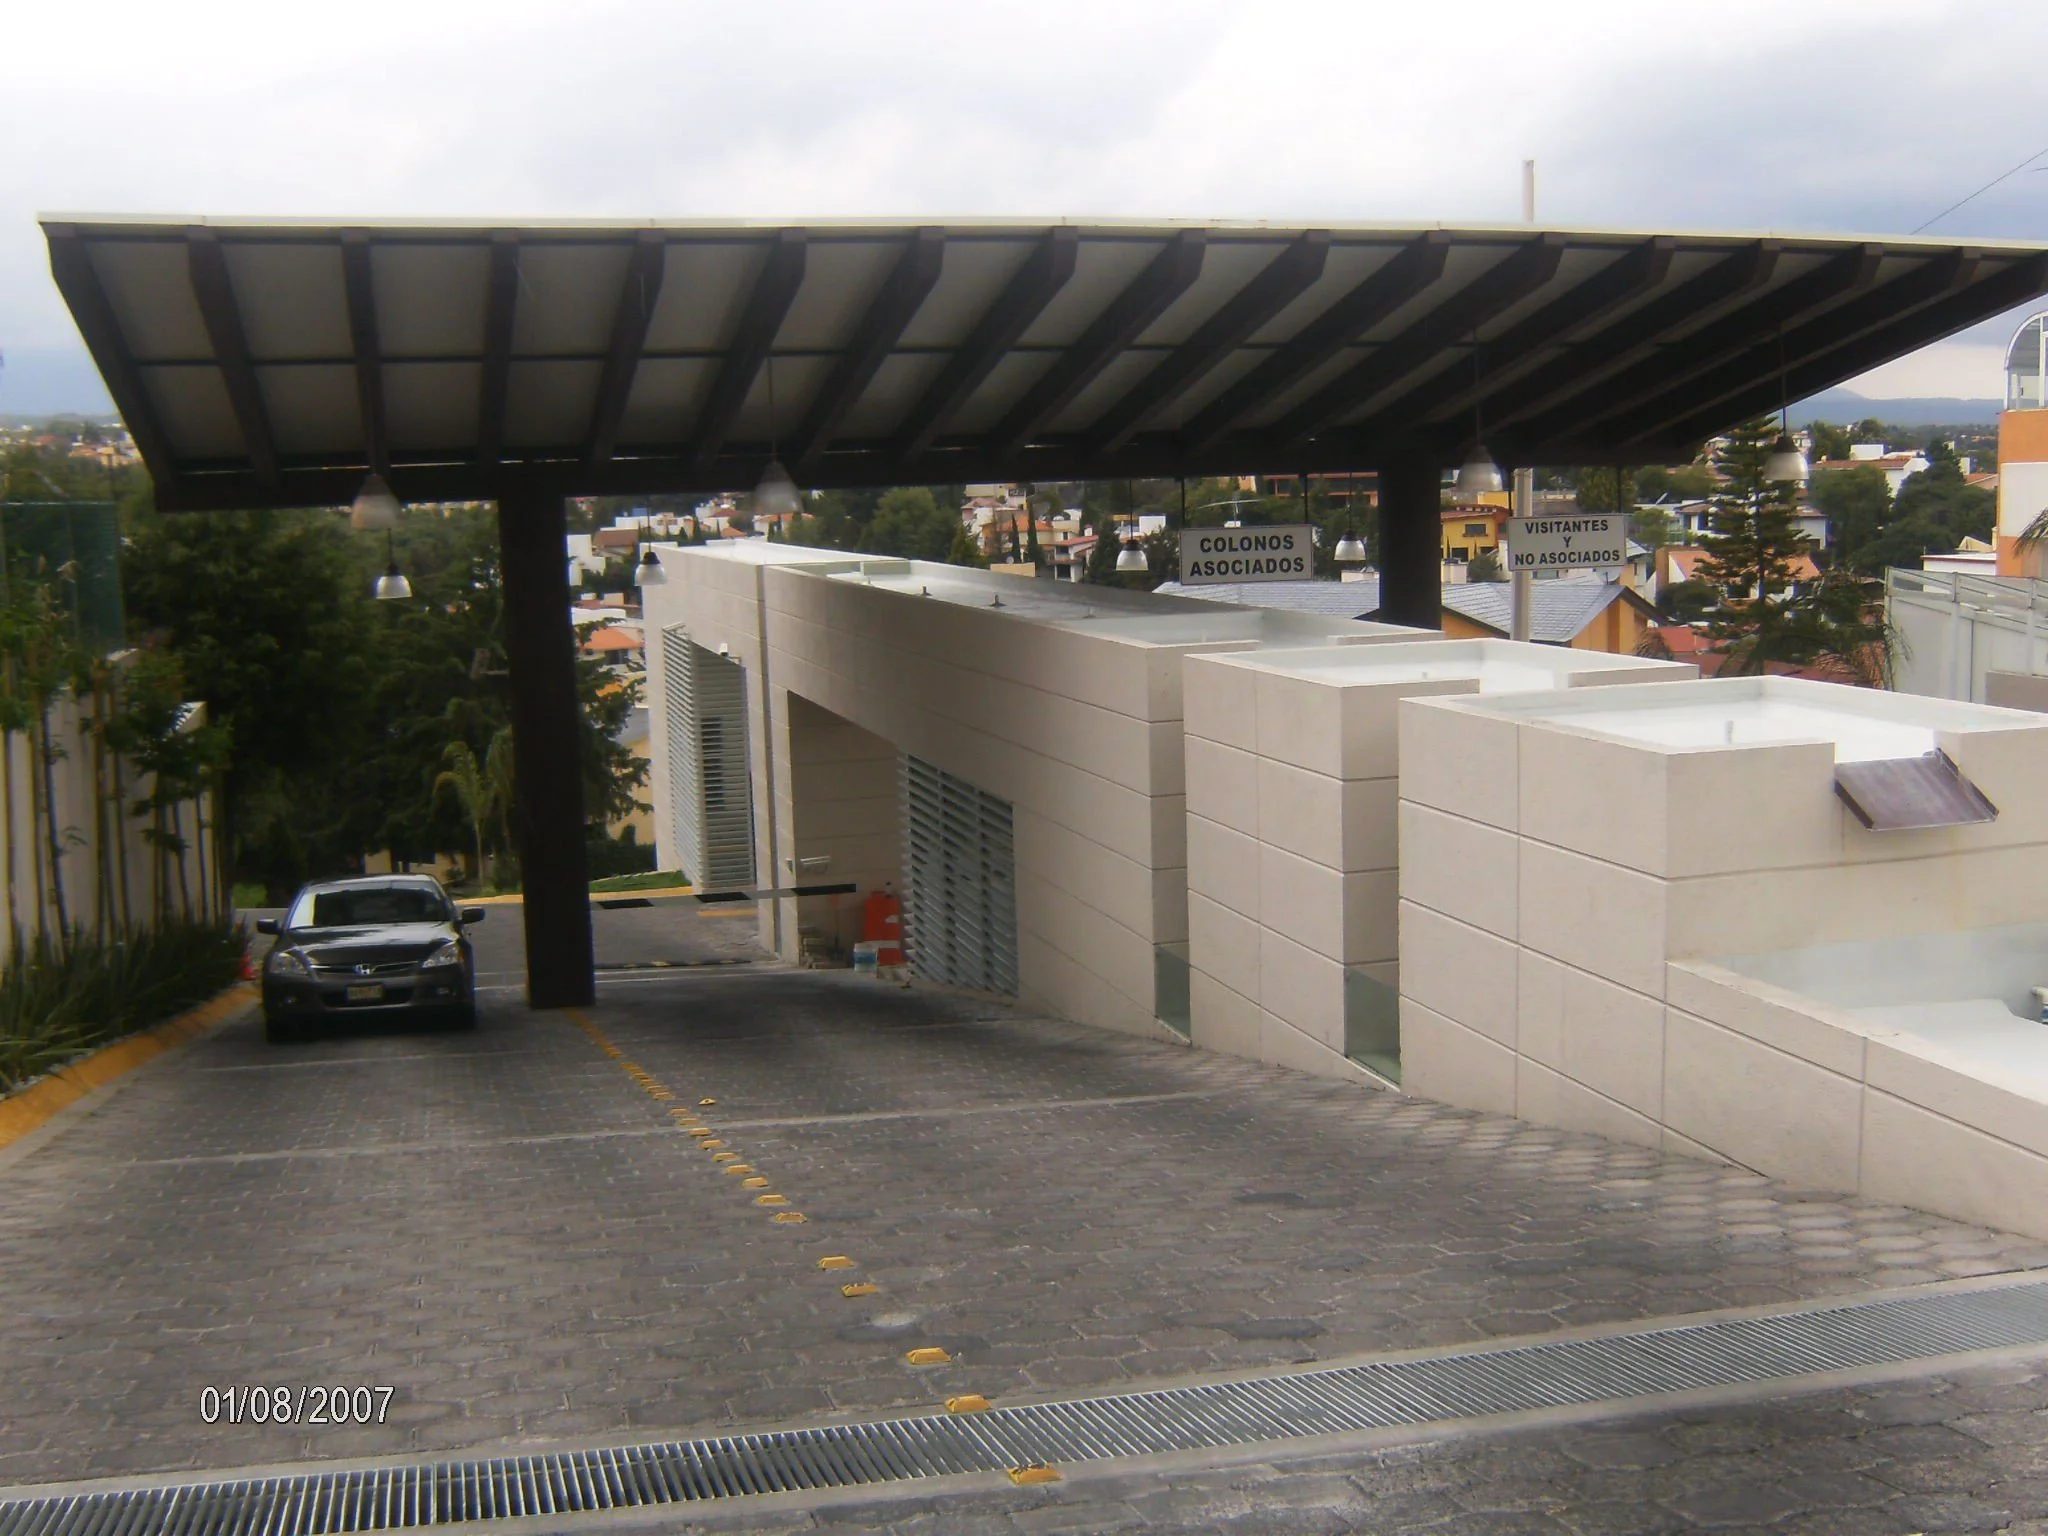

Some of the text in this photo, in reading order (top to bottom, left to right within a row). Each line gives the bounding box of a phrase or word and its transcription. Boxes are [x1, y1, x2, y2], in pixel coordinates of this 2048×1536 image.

[1525, 520, 1609, 534] VISITANTES
[1200, 535, 1294, 553] COLONOS
[1563, 536, 1572, 548] Y
[1515, 550, 1620, 565] NO ASOCIADOS
[1190, 557, 1304, 577] ASOCIADOS
